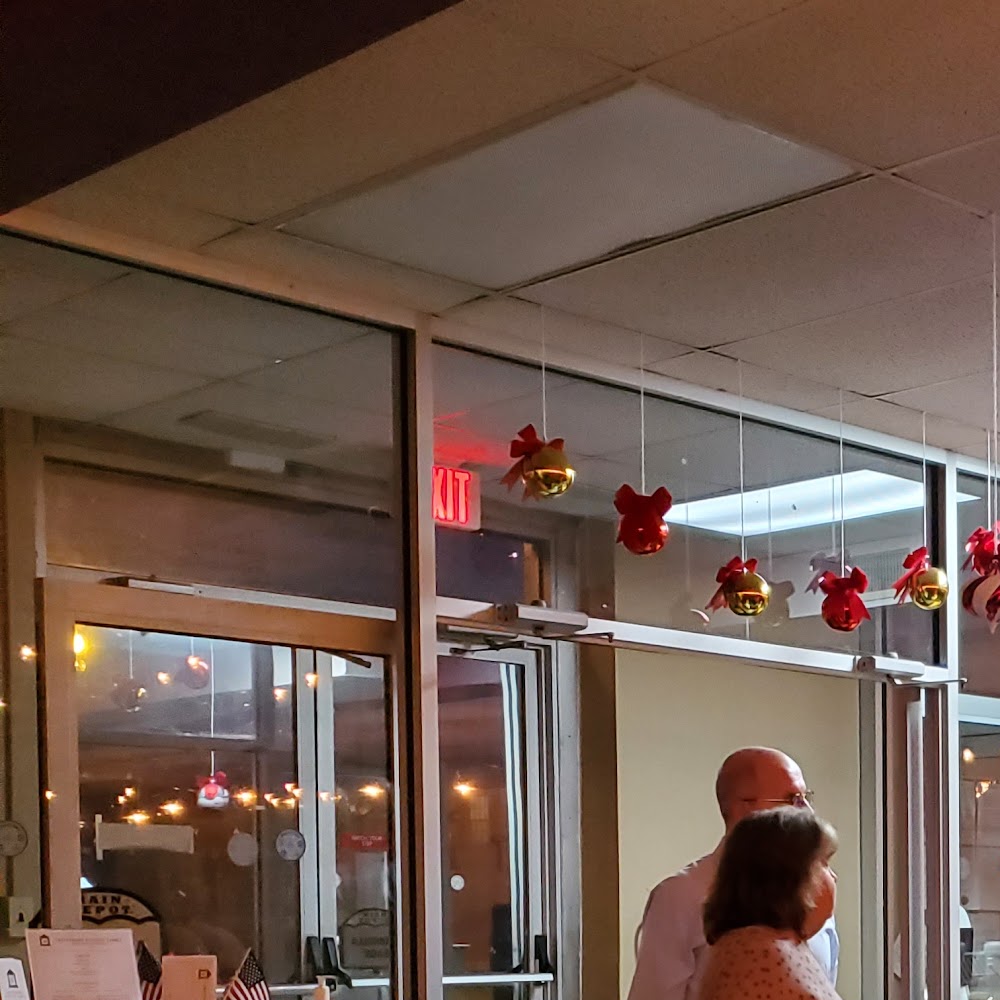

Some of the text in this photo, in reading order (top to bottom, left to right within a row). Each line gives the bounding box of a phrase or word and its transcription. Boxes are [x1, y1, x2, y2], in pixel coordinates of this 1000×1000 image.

[433, 468, 470, 523] XIT
[82, 894, 121, 905] AIN
[82, 905, 130, 914] EPOT
